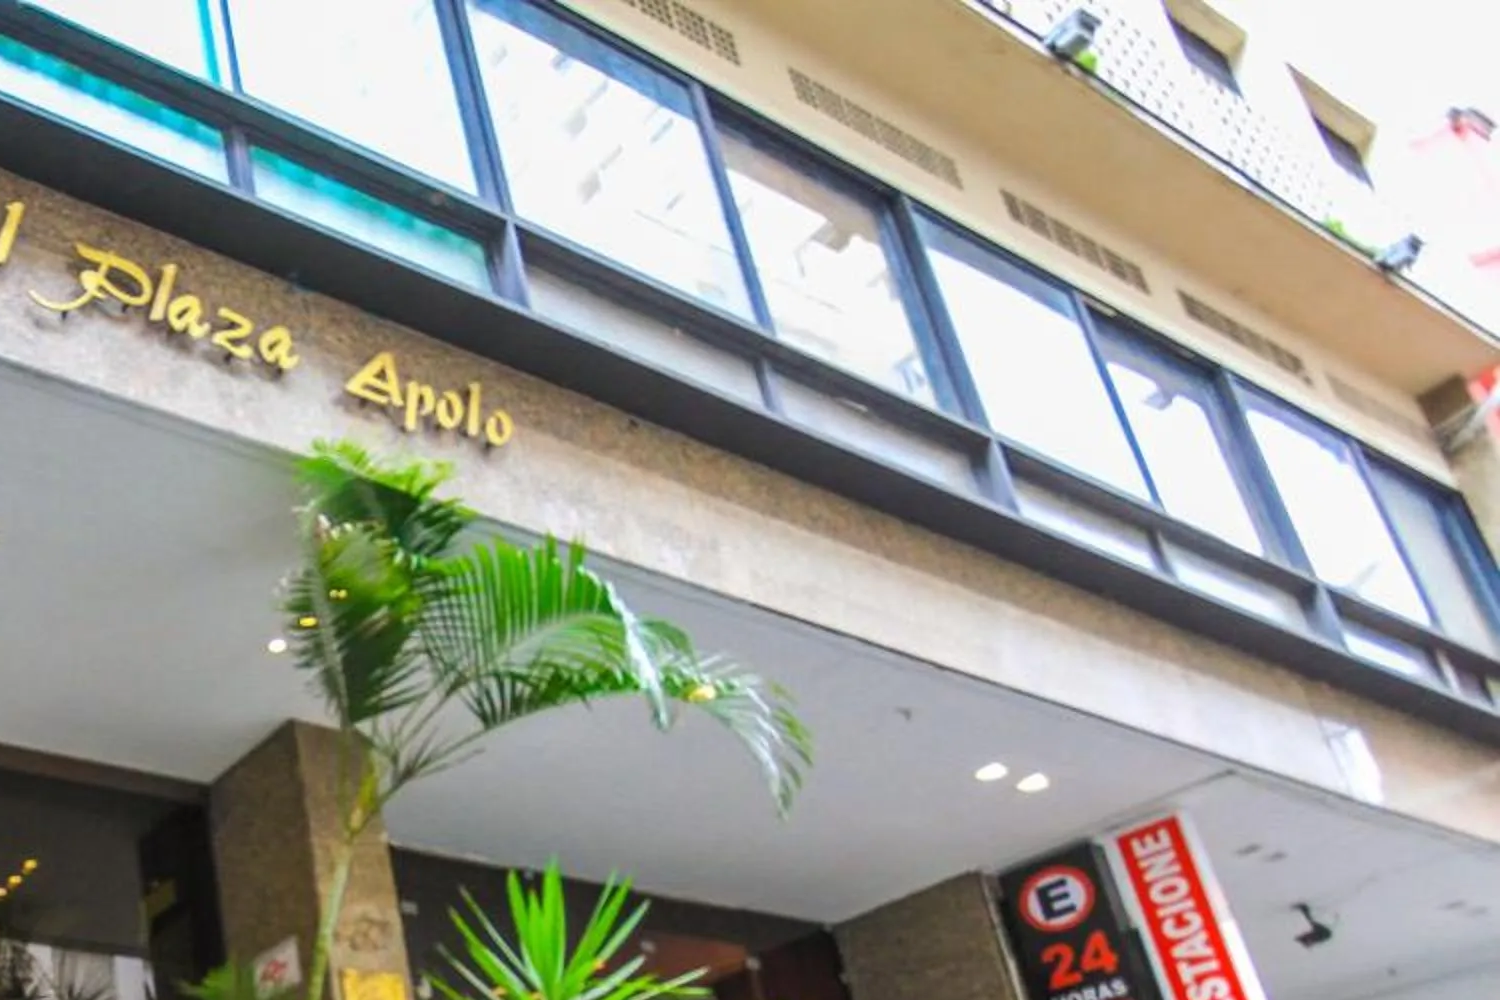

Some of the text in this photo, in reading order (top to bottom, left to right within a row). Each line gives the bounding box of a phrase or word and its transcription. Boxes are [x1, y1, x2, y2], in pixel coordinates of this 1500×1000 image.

[28, 243, 299, 371] Plaza
[345, 352, 515, 447] Apolo
[1035, 877, 1077, 921] E
[1041, 929, 1119, 989] 24
